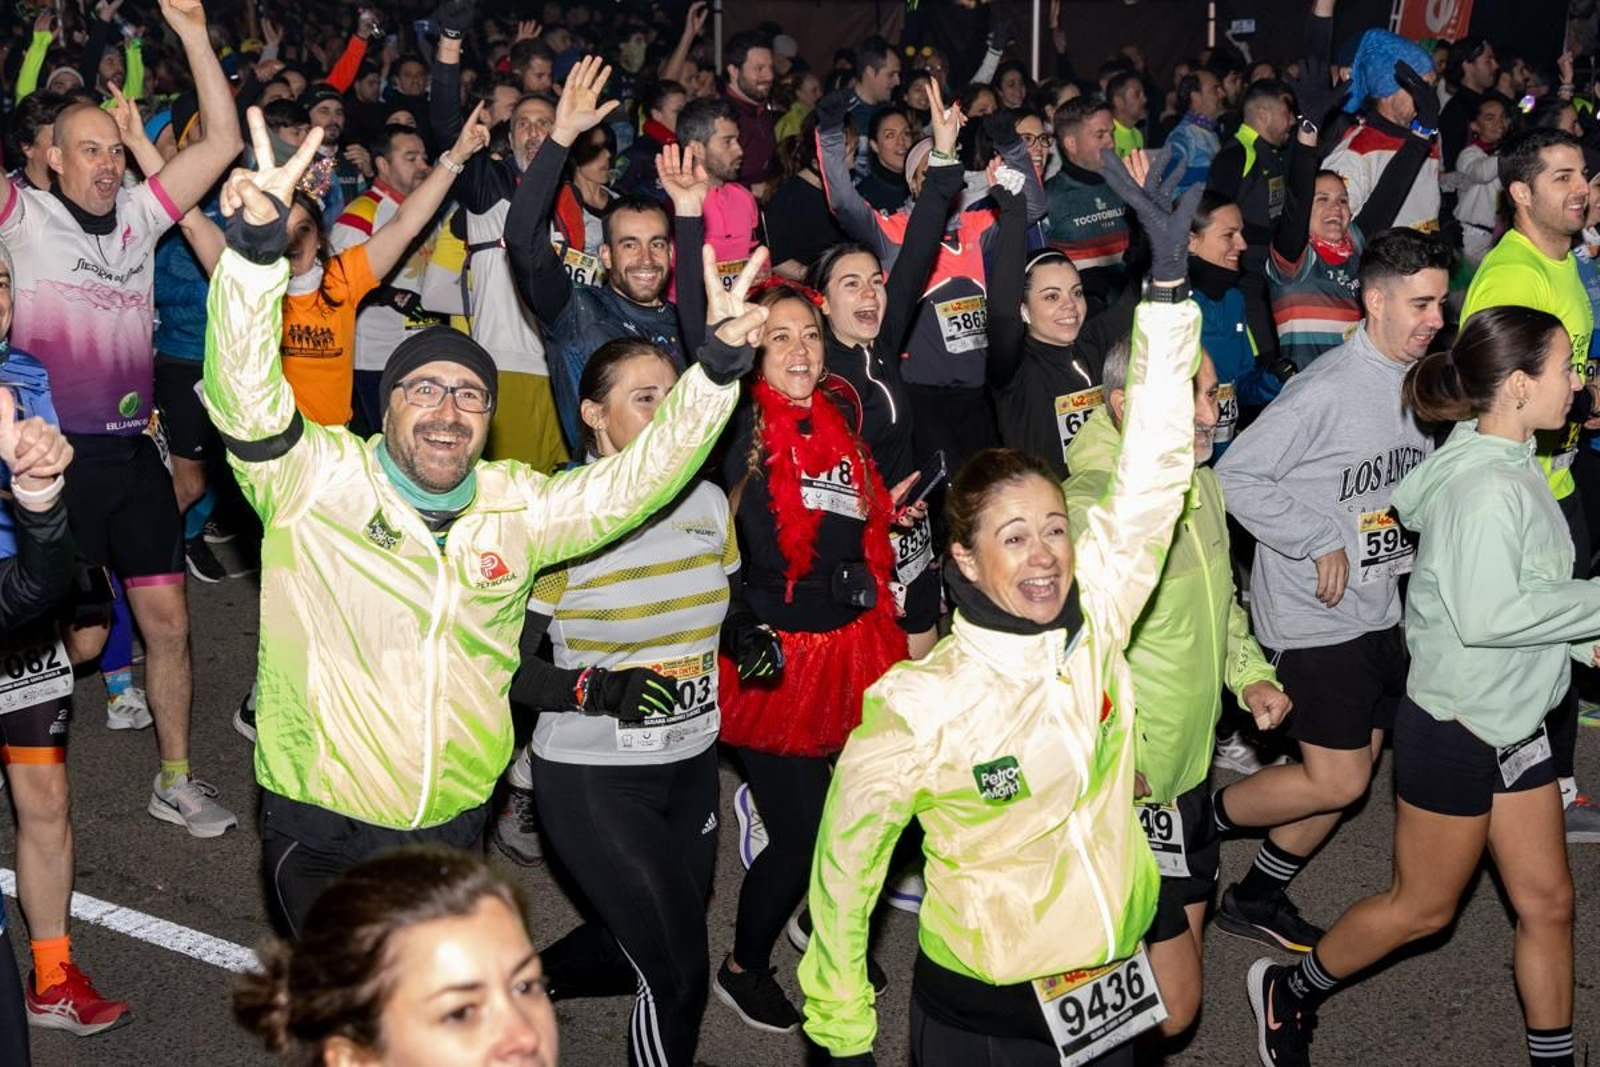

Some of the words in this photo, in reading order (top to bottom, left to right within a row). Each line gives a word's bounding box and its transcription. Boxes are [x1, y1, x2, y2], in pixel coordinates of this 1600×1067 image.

[1338, 455, 1384, 503] LOS
[1384, 446, 1427, 487] ANGE
[1058, 960, 1145, 1037] 9436
